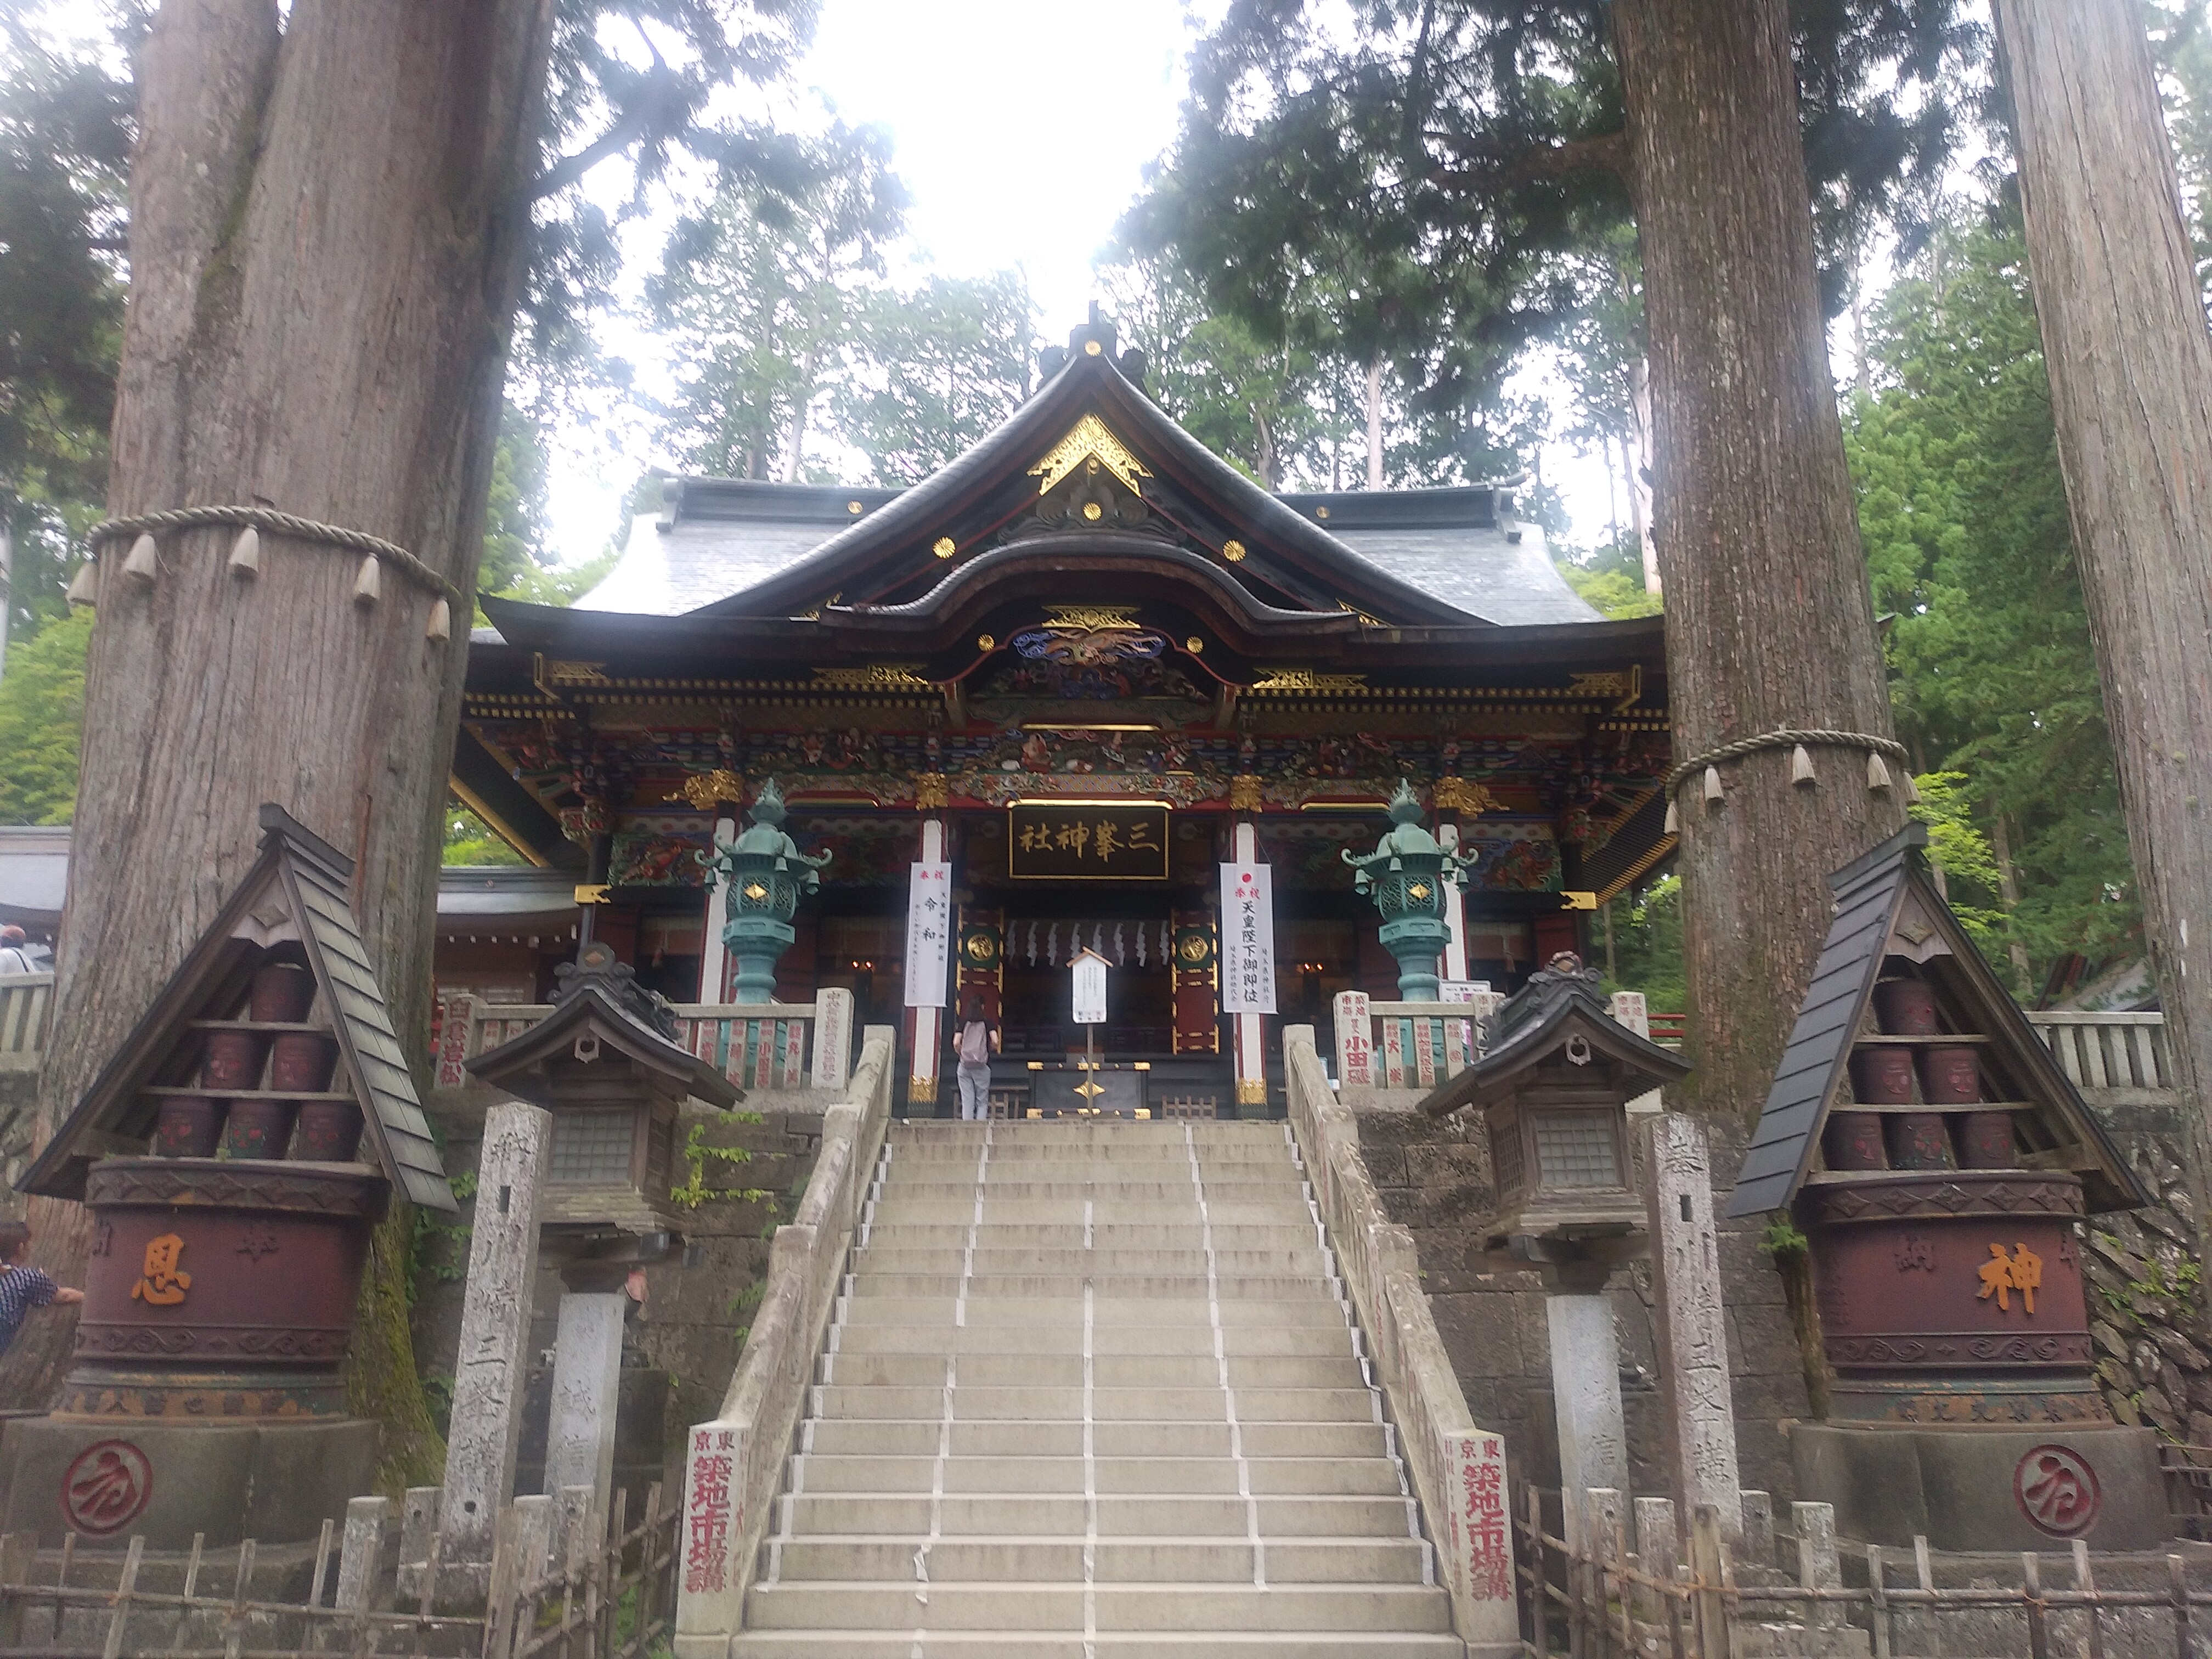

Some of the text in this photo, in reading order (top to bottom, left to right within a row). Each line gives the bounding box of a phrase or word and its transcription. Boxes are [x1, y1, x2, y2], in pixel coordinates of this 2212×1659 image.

[1019, 819, 1159, 862] 三峯神社
[1242, 900, 1258, 1003] 天皇陛下御即位
[1976, 1242, 2043, 1314] 神
[685, 1455, 733, 1593] 築地市場講
[1463, 1462, 1511, 1601] 築地市場講
